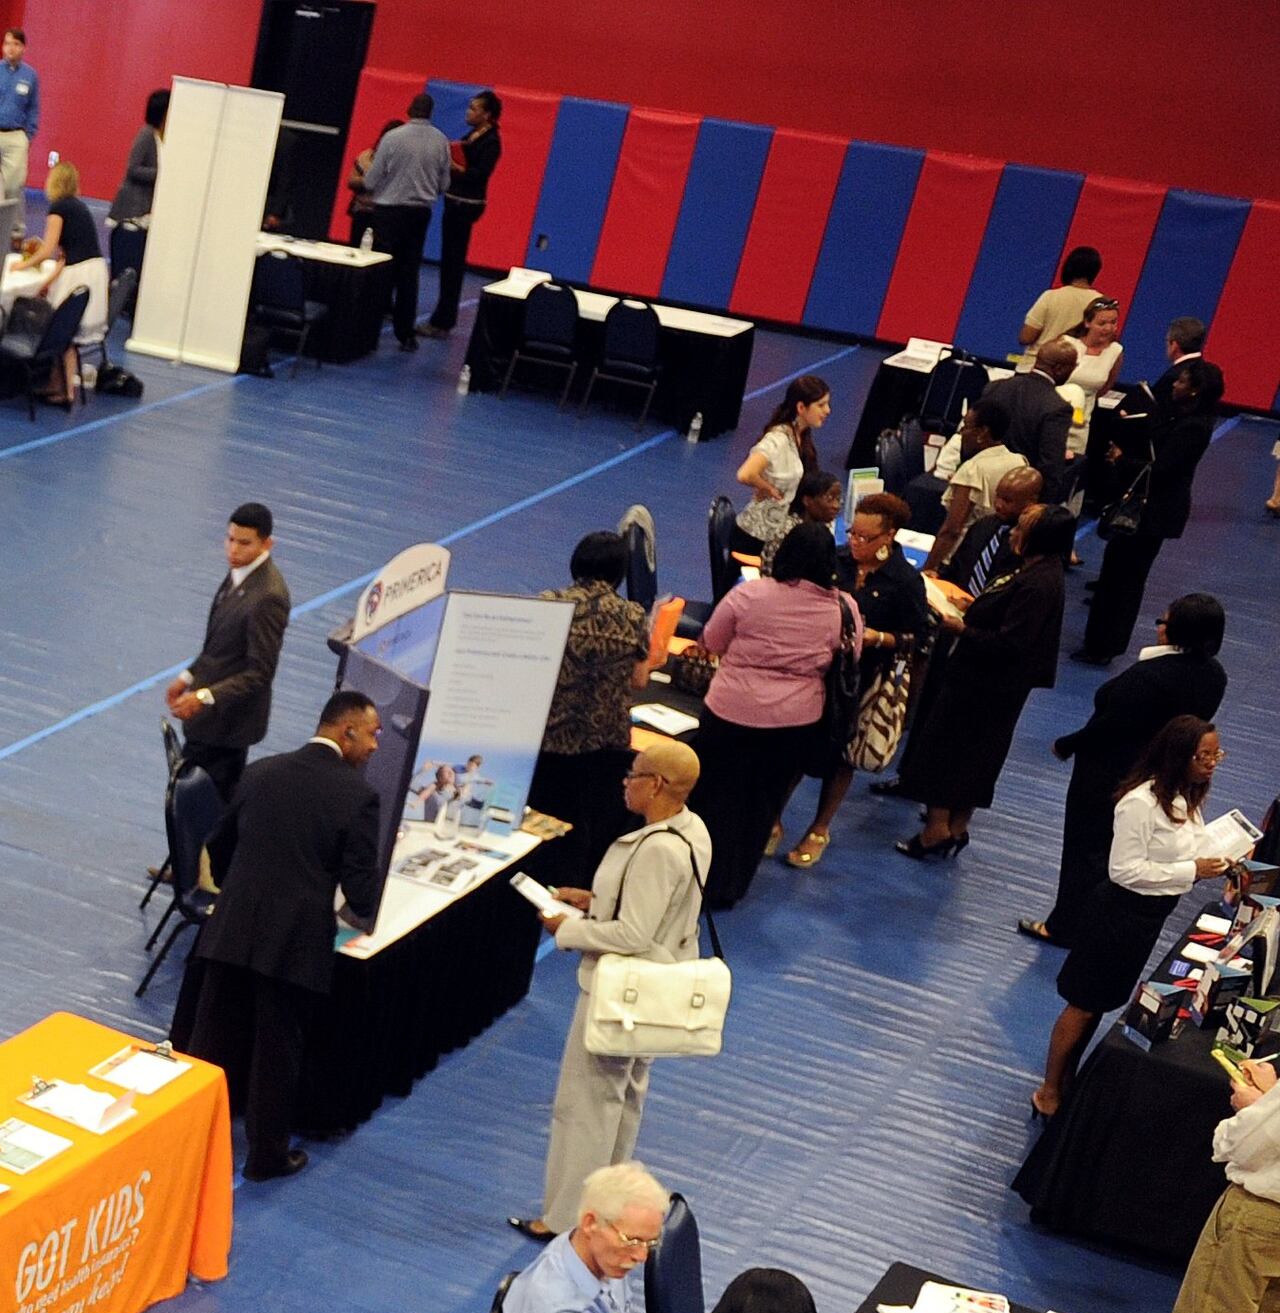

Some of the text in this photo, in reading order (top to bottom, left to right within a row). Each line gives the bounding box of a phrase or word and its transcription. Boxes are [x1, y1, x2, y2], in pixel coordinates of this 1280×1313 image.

[383, 560, 442, 606] PRIMERICA
[15, 1170, 152, 1304] GOT KIDS
[36, 1283, 61, 1310] need
[60, 1265, 90, 1297] health
[90, 1227, 140, 1275] insurance?
[87, 1250, 130, 1306] help!
